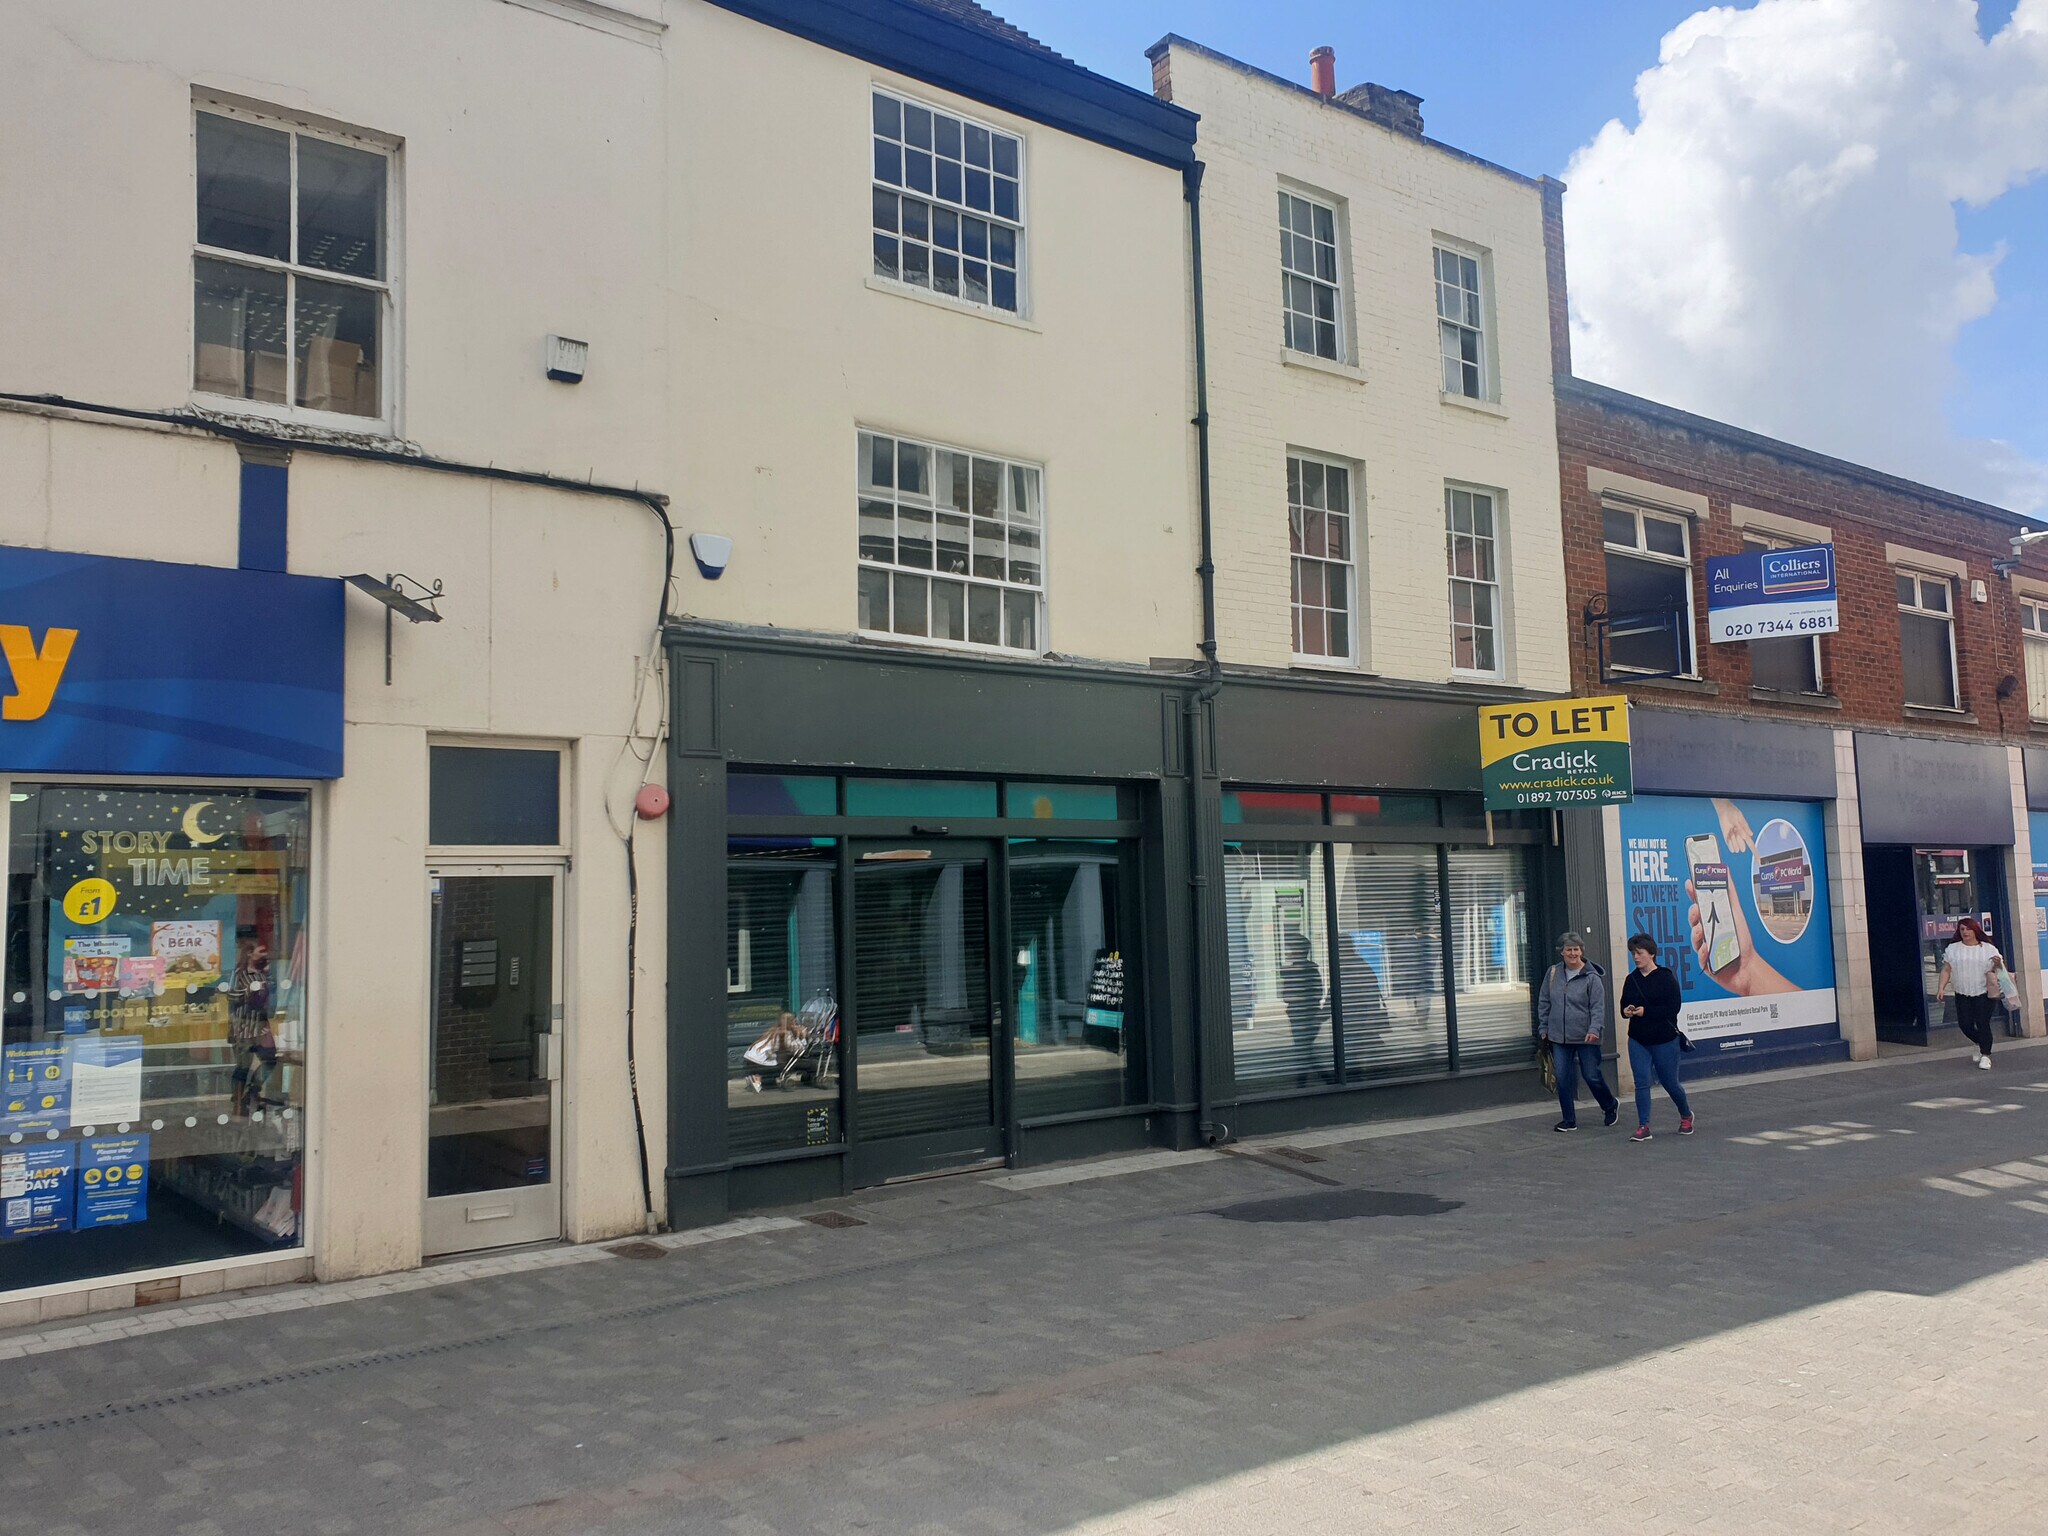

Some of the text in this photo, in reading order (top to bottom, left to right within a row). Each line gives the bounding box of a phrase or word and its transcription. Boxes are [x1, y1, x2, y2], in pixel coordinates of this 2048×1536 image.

[1769, 558, 1821, 573] Colliers
[1714, 568, 1729, 580] All
[1770, 569, 1821, 579] INTERNATIONAL
[1714, 581, 1758, 594] Enquiries
[1725, 616, 1833, 637] 020 7344 6881
[1490, 706, 1615, 739] TO LET
[1512, 750, 1598, 772] Cradick
[1499, 774, 1615, 790] www.cradick.co.uk
[1517, 792, 1552, 803] 01892
[1555, 790, 1597, 801] 707505
[81, 830, 173, 854] STORY
[1628, 838, 1637, 849] WE
[1649, 838, 1659, 849] NOT
[1660, 839, 1667, 849] BE
[128, 857, 210, 886] TIME
[1628, 850, 1678, 882] HERE...
[1695, 867, 1707, 875] Currys
[1761, 866, 1802, 881] Currys PC World
[1631, 884, 1679, 903] BUT WE'RE
[79, 896, 102, 917] £1
[1632, 906, 1684, 944] STILL
[168, 937, 203, 948] BEAR
[93, 1005, 134, 1020] BOOKS
[136, 1004, 149, 1018] IN
[6, 1049, 45, 1058] Welcome
[45, 1046, 69, 1056] Back!
[25, 1165, 71, 1180] HAPPY
[25, 1178, 59, 1192] DAYS
